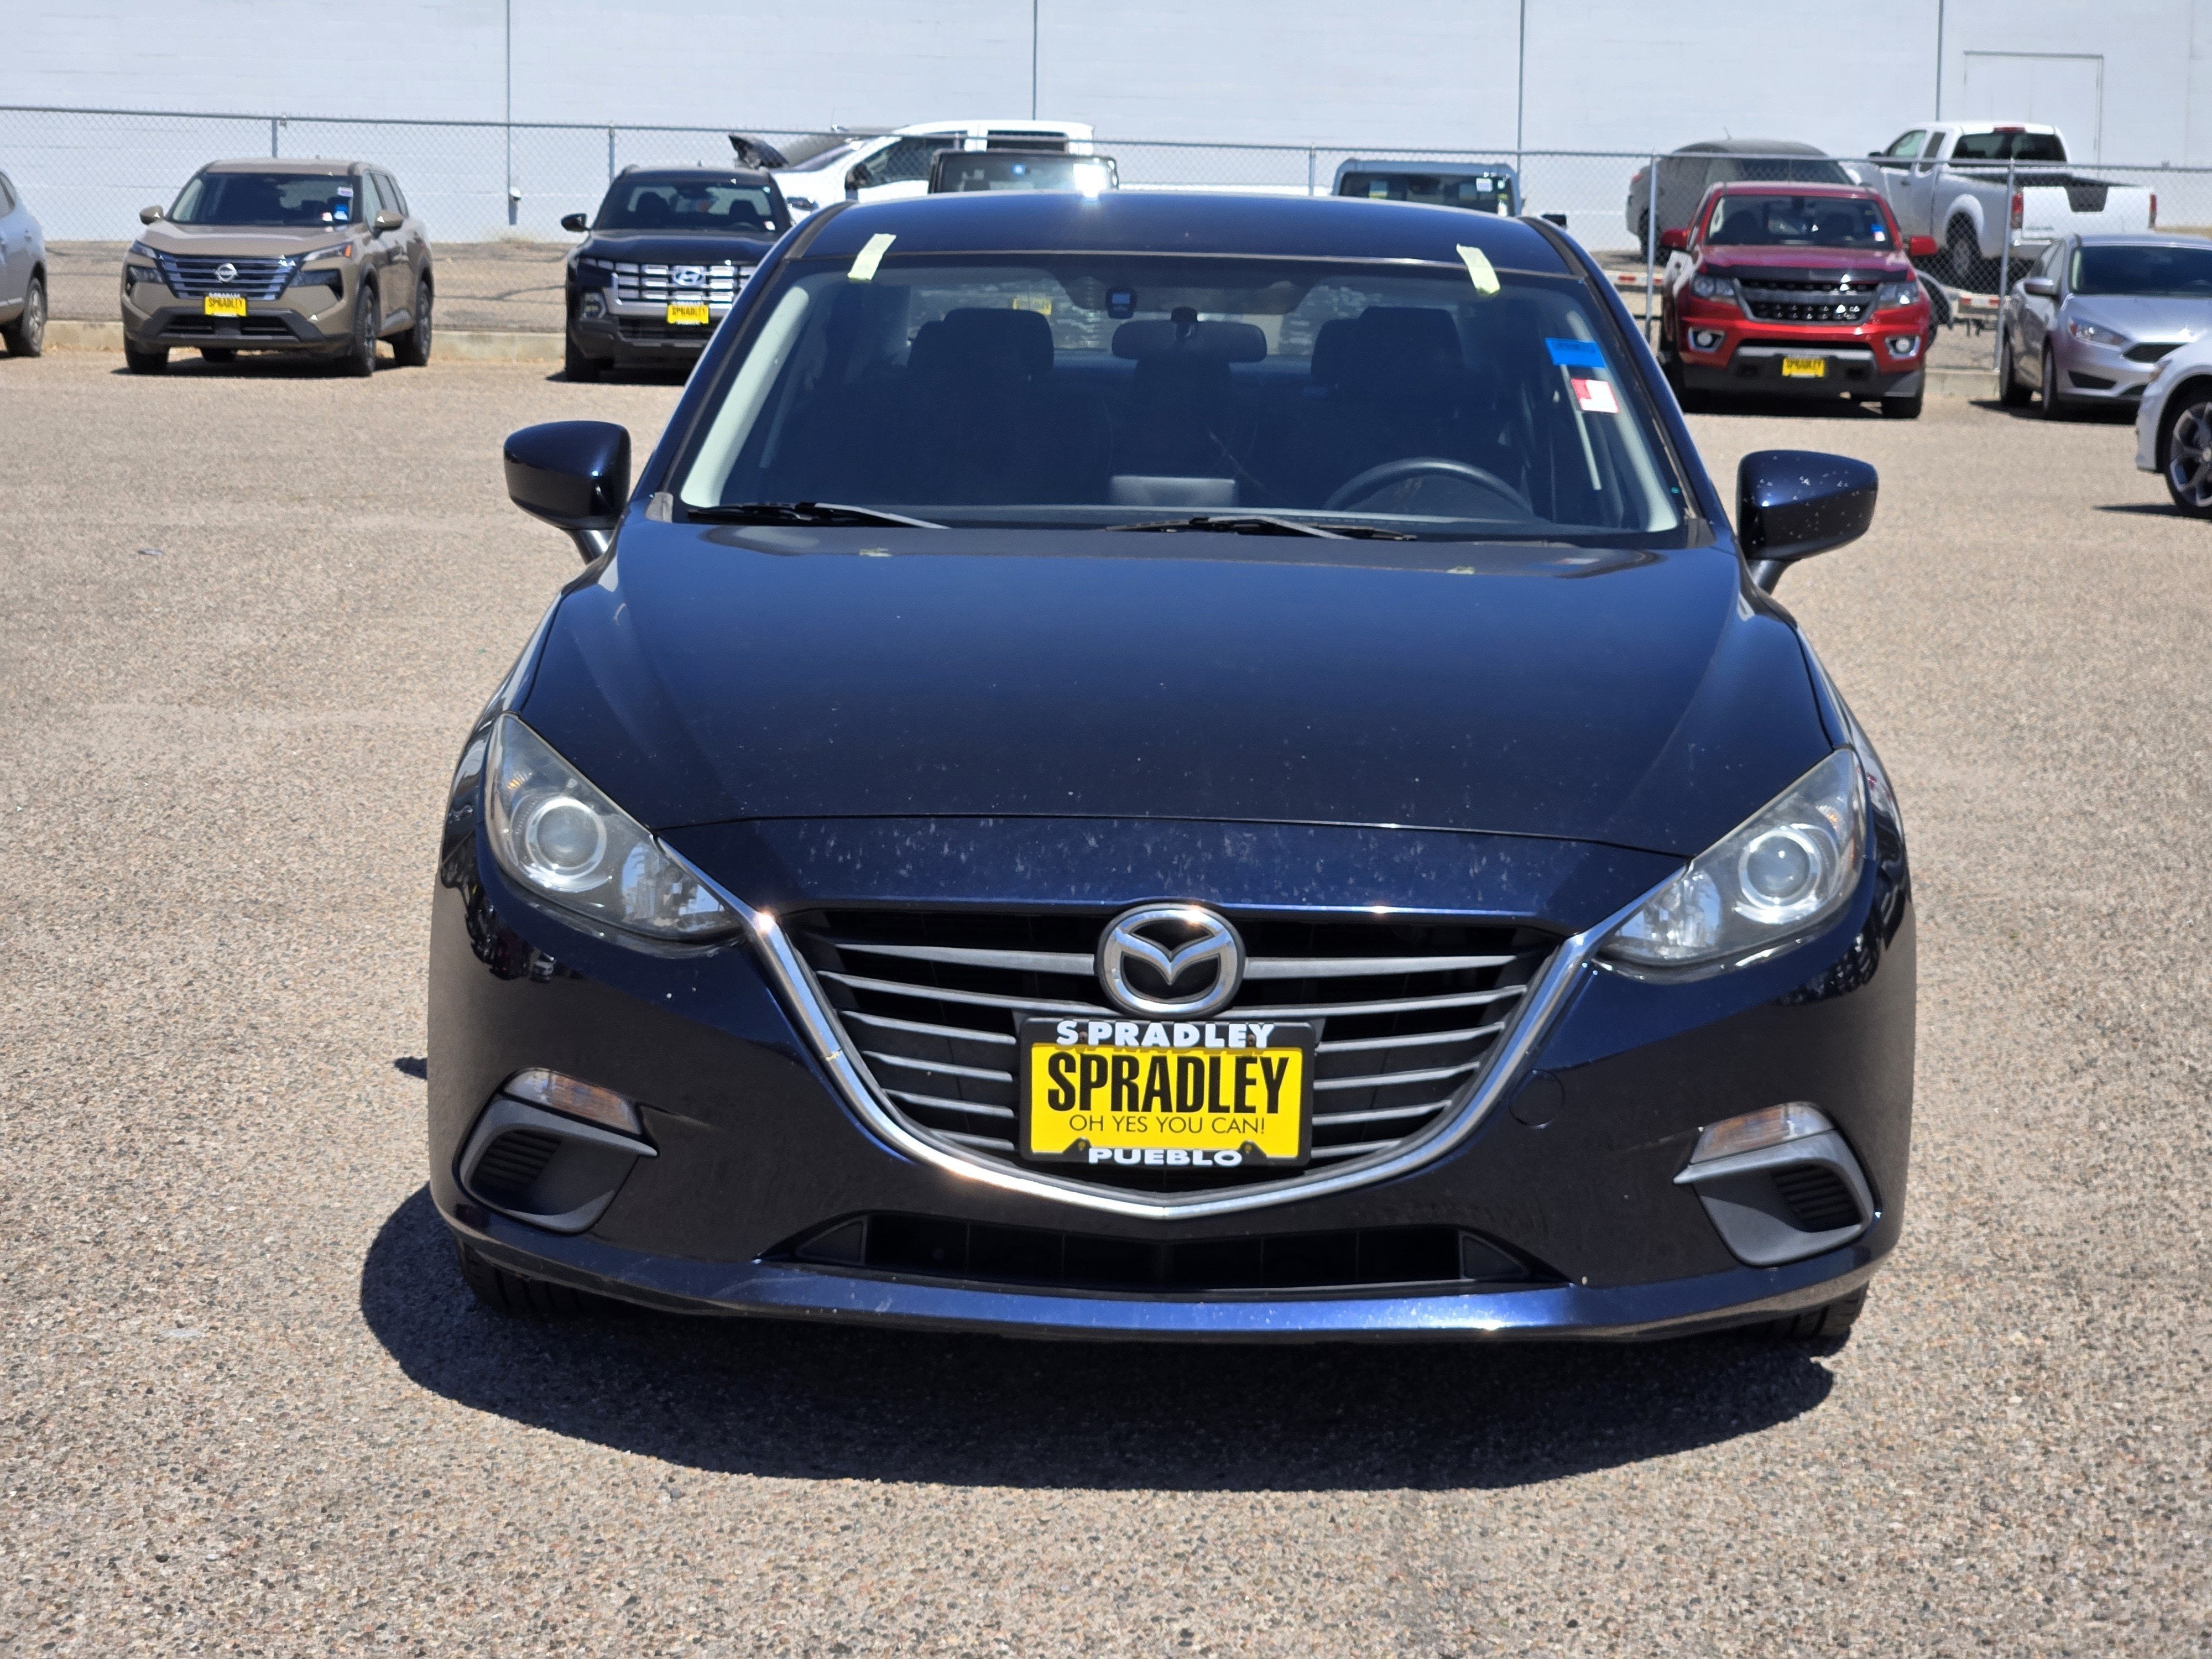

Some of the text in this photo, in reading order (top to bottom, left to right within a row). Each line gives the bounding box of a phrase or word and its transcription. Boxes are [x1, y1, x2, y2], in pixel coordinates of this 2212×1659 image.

[1057, 1021, 1274, 1048] SPRADLEY
[1048, 1051, 1289, 1114] SPRADLEY
[1070, 1114, 1265, 1134] OH YES YOU CAN!
[1088, 1147, 1242, 1167] PUEBLO
